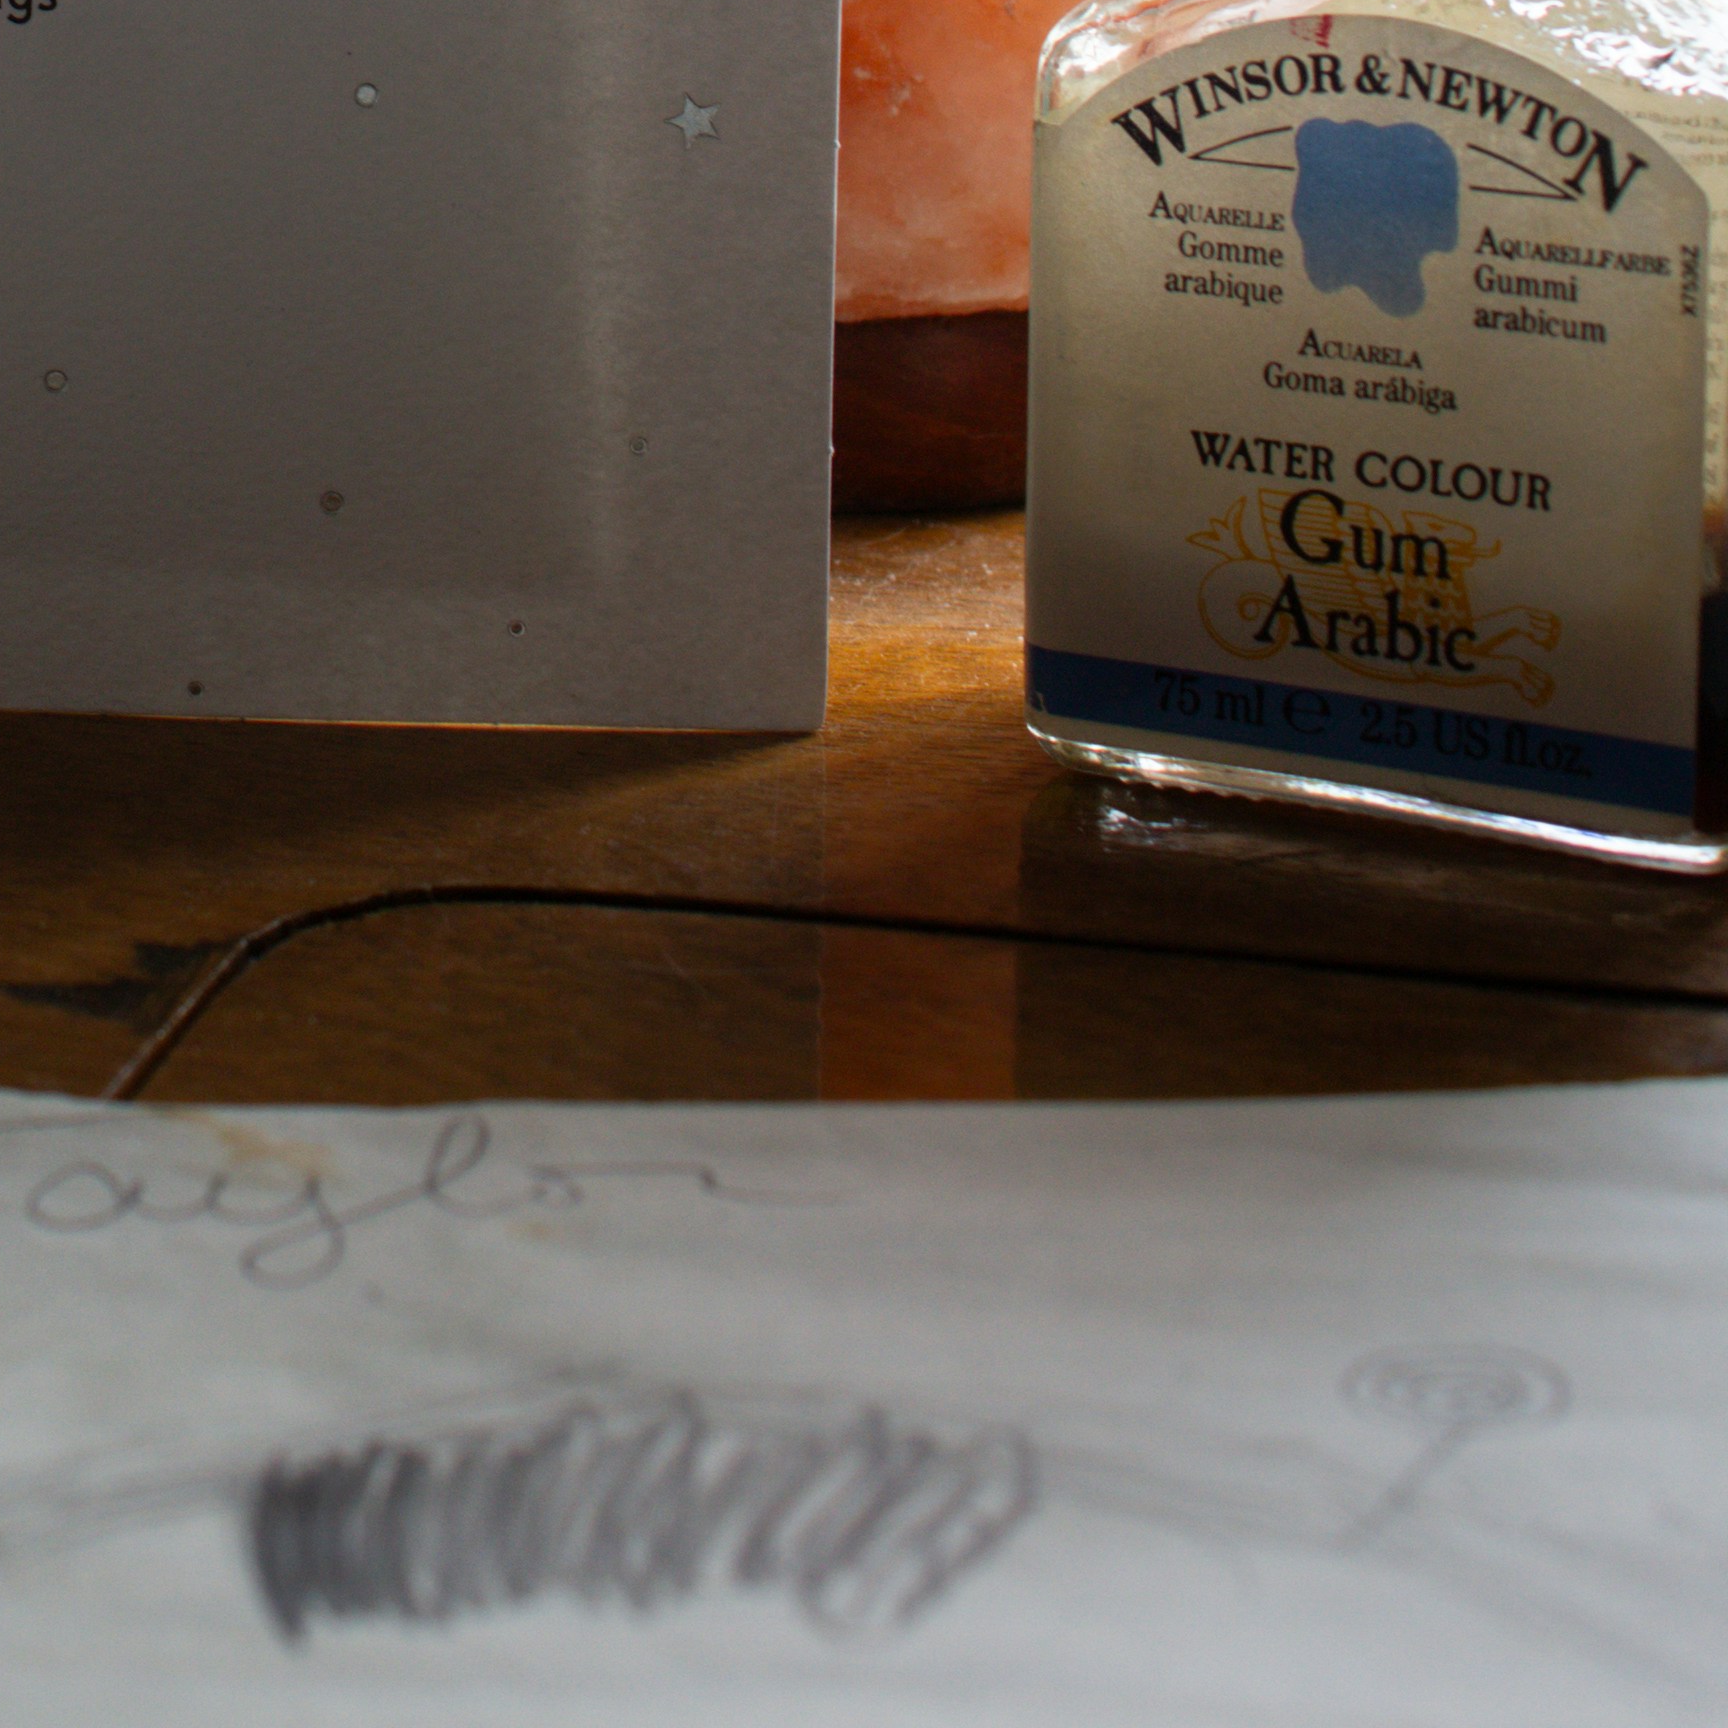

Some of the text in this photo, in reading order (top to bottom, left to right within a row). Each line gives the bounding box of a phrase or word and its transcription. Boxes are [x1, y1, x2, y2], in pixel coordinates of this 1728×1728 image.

[1110, 52, 1345, 168] WINSOR
[1354, 53, 1391, 96] &
[1395, 57, 1648, 213] NEWTON
[1148, 189, 1285, 232] AQUARELLE
[1176, 231, 1284, 268] Gomme
[1163, 269, 1284, 308] arabique
[1473, 264, 1579, 303] Gummi
[1473, 302, 1607, 344] arabicum
[1297, 327, 1423, 370] ACUARELA
[1262, 361, 1459, 414] Goma arábiga
[1190, 429, 1552, 511] WATER COLOUR
[1279, 488, 1452, 581] Gum
[1251, 573, 1478, 672] Arabic
[1153, 667, 1201, 716] 75
[1214, 684, 1265, 727] ml
[1432, 713, 1490, 761] US
